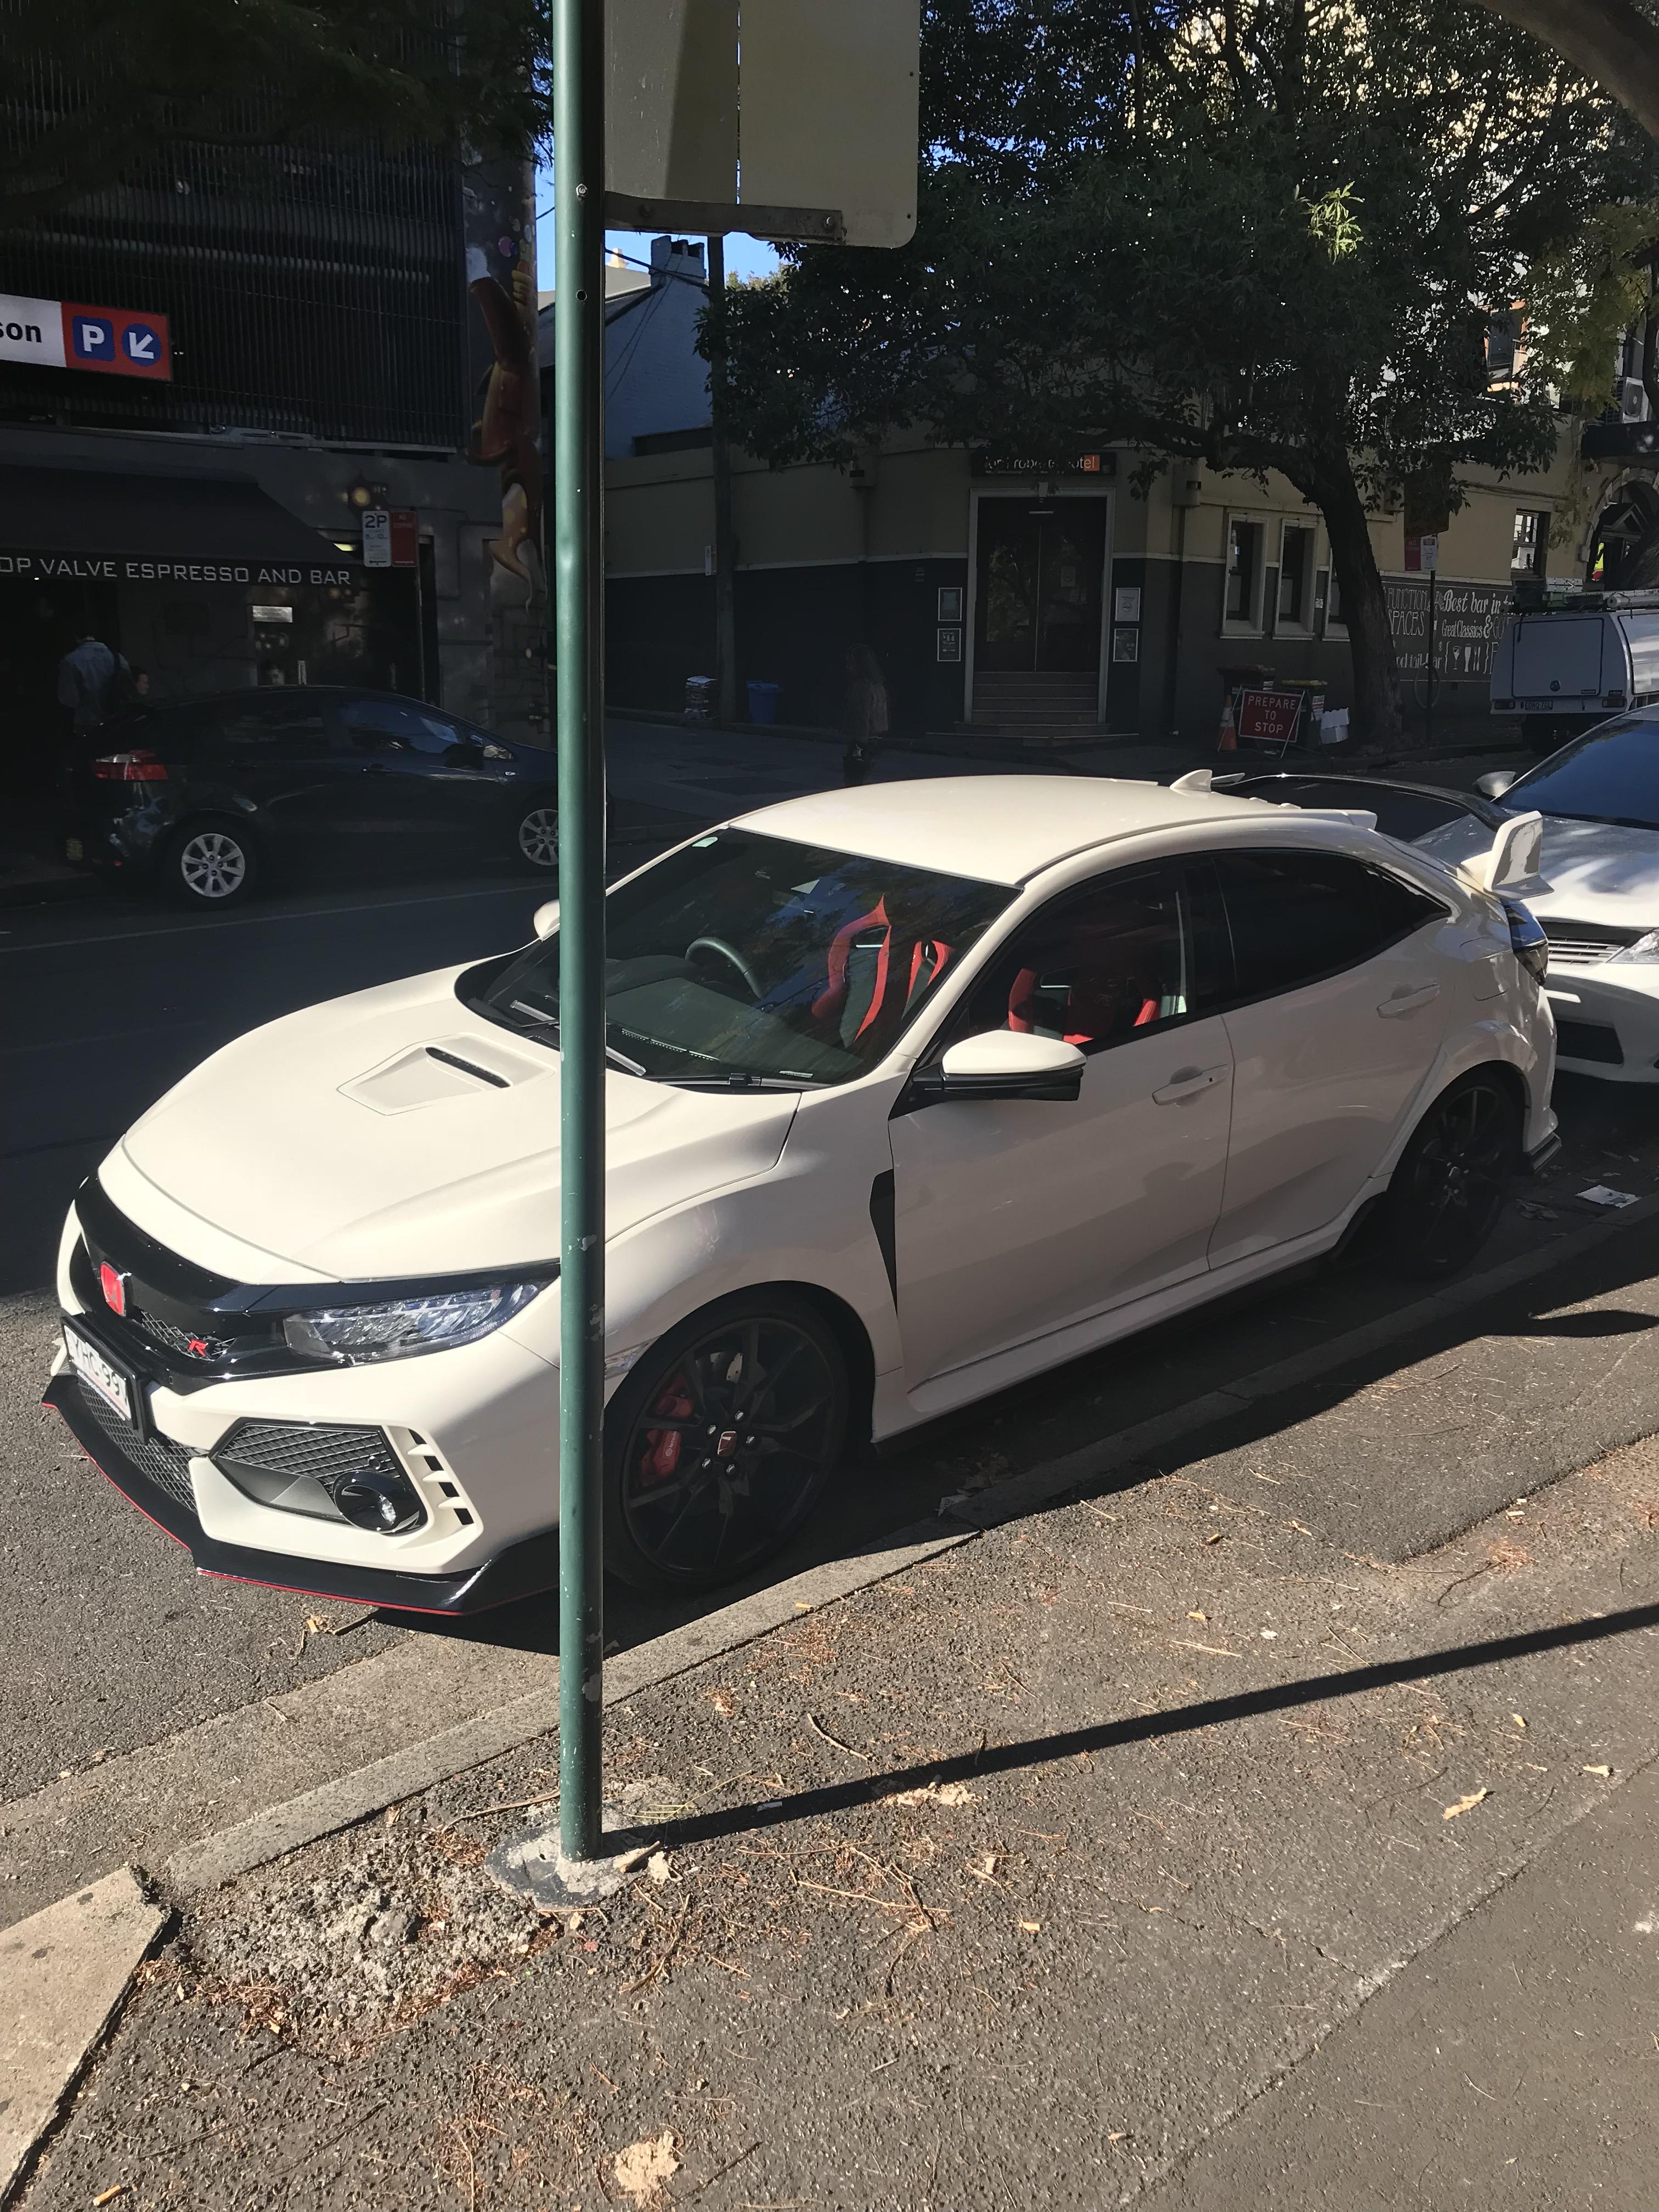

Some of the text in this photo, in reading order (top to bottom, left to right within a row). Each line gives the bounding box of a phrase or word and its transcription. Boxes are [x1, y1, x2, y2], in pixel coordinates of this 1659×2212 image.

[82, 323, 105, 352] P
[365, 515, 387, 528] 2P
[39, 557, 117, 578] VALVE
[126, 562, 250, 583] ESPRESSO
[258, 568, 302, 584] AND
[310, 569, 351, 585] BAR
[1443, 589, 1469, 613] Best
[1471, 591, 1488, 614] bar
[1491, 592, 1501, 614] in
[1442, 619, 1457, 637] Great
[1457, 619, 1482, 639] Classics
[1248, 695, 1296, 710] PREPARE
[1265, 710, 1277, 720] TO
[1254, 722, 1284, 733] STOP
